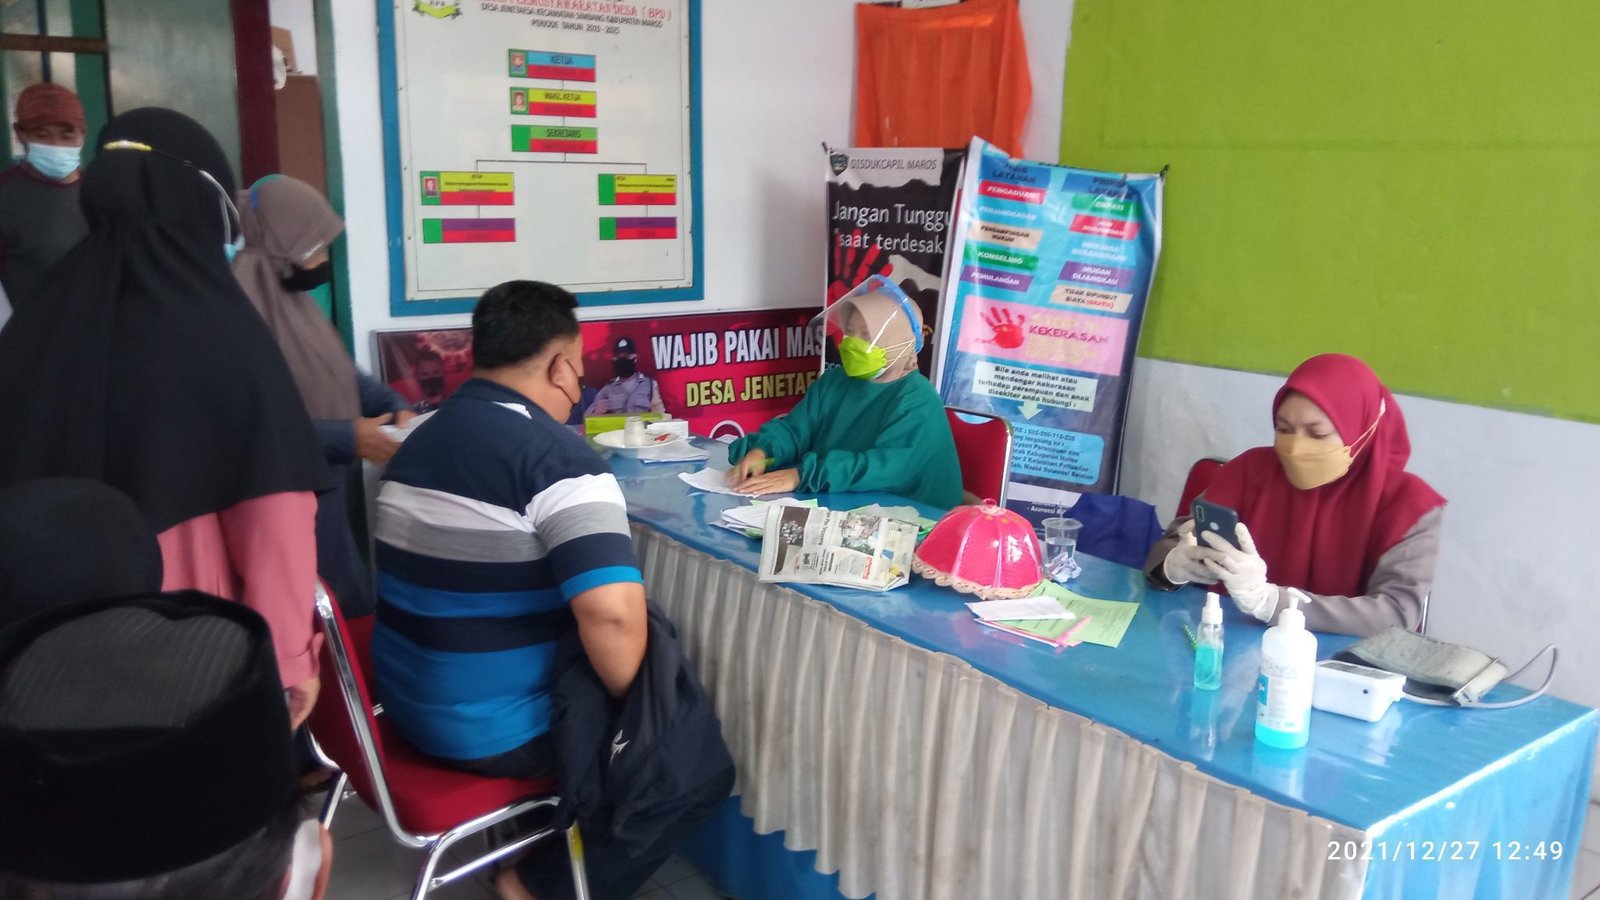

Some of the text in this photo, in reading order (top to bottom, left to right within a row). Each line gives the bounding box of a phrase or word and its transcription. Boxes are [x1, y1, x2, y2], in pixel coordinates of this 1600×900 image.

[850, 159, 938, 170] DISDUKCAPIL MAROS
[832, 200, 889, 227] Jangan
[839, 232, 944, 254] saat terdesak
[970, 271, 1021, 286] PEMULANGAN
[1028, 324, 1109, 344] KEKERASAN
[652, 332, 718, 371] WAJIB
[724, 328, 780, 364] PAKAI
[994, 373, 1077, 392] mendengar kekerasan
[1010, 368, 1030, 377] anda
[1031, 370, 1060, 381] melihat
[687, 379, 736, 407] DESA
